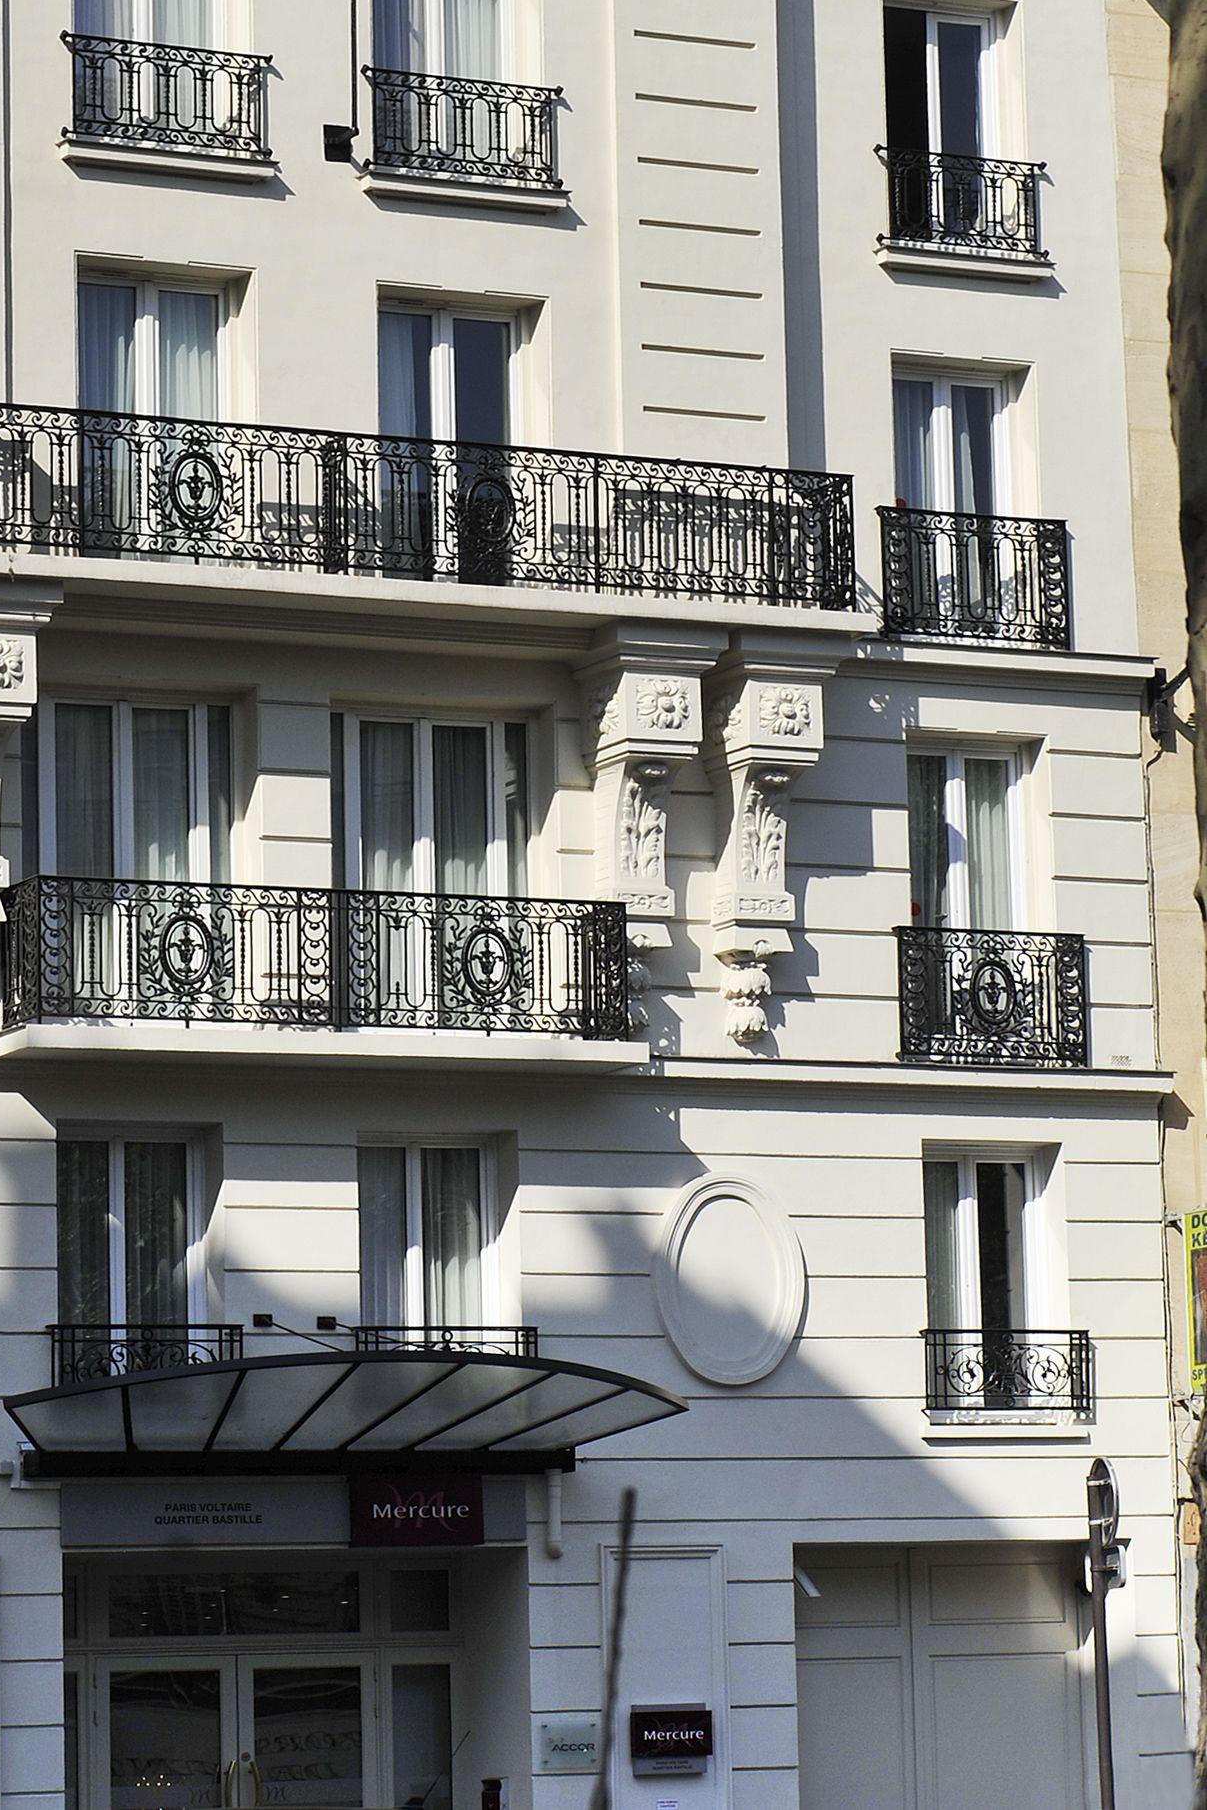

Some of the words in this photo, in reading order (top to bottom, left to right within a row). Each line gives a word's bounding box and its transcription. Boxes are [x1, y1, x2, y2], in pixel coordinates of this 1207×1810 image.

[165, 1503, 197, 1513] PARIS
[199, 1502, 252, 1512] VOLTAIRE
[373, 1503, 470, 1519] Mercure
[154, 1515, 210, 1525] QUARTIER
[212, 1514, 263, 1525] BASTILLE
[644, 1729, 705, 1741] Mercure
[552, 1742, 596, 1752] ACCOR
